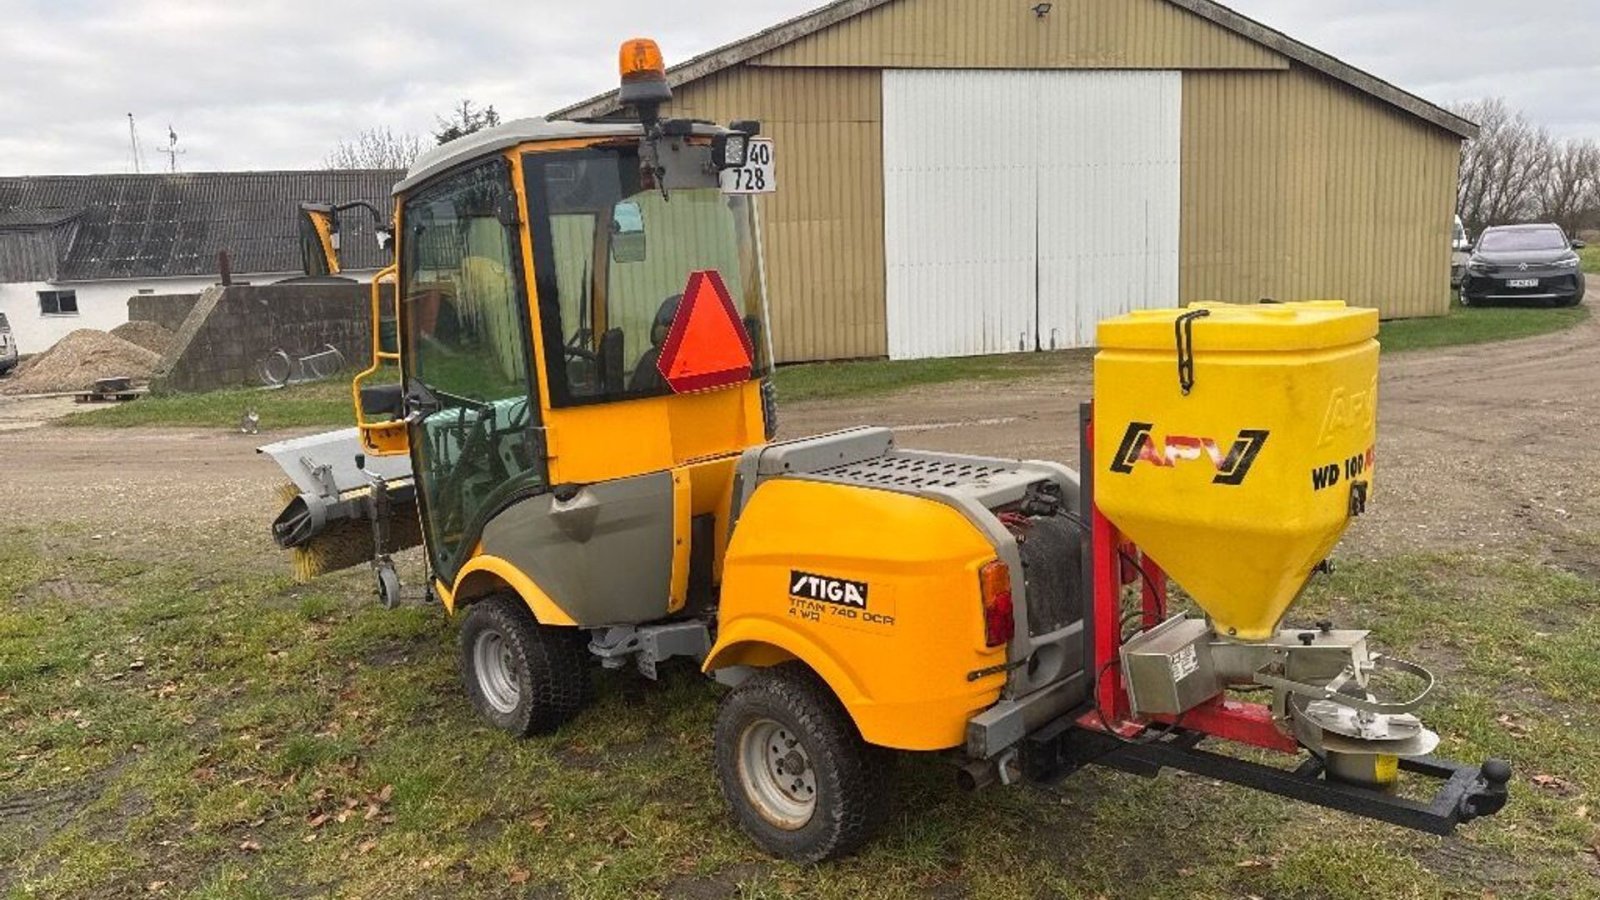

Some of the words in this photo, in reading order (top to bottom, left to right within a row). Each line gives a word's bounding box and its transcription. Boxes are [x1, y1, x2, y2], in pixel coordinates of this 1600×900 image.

[750, 144, 769, 165] 40
[733, 168, 765, 190] 728
[1312, 463, 1340, 491] WD
[1345, 453, 1364, 480] 100
[792, 576, 863, 606] STIGA
[788, 598, 826, 613] TITAN
